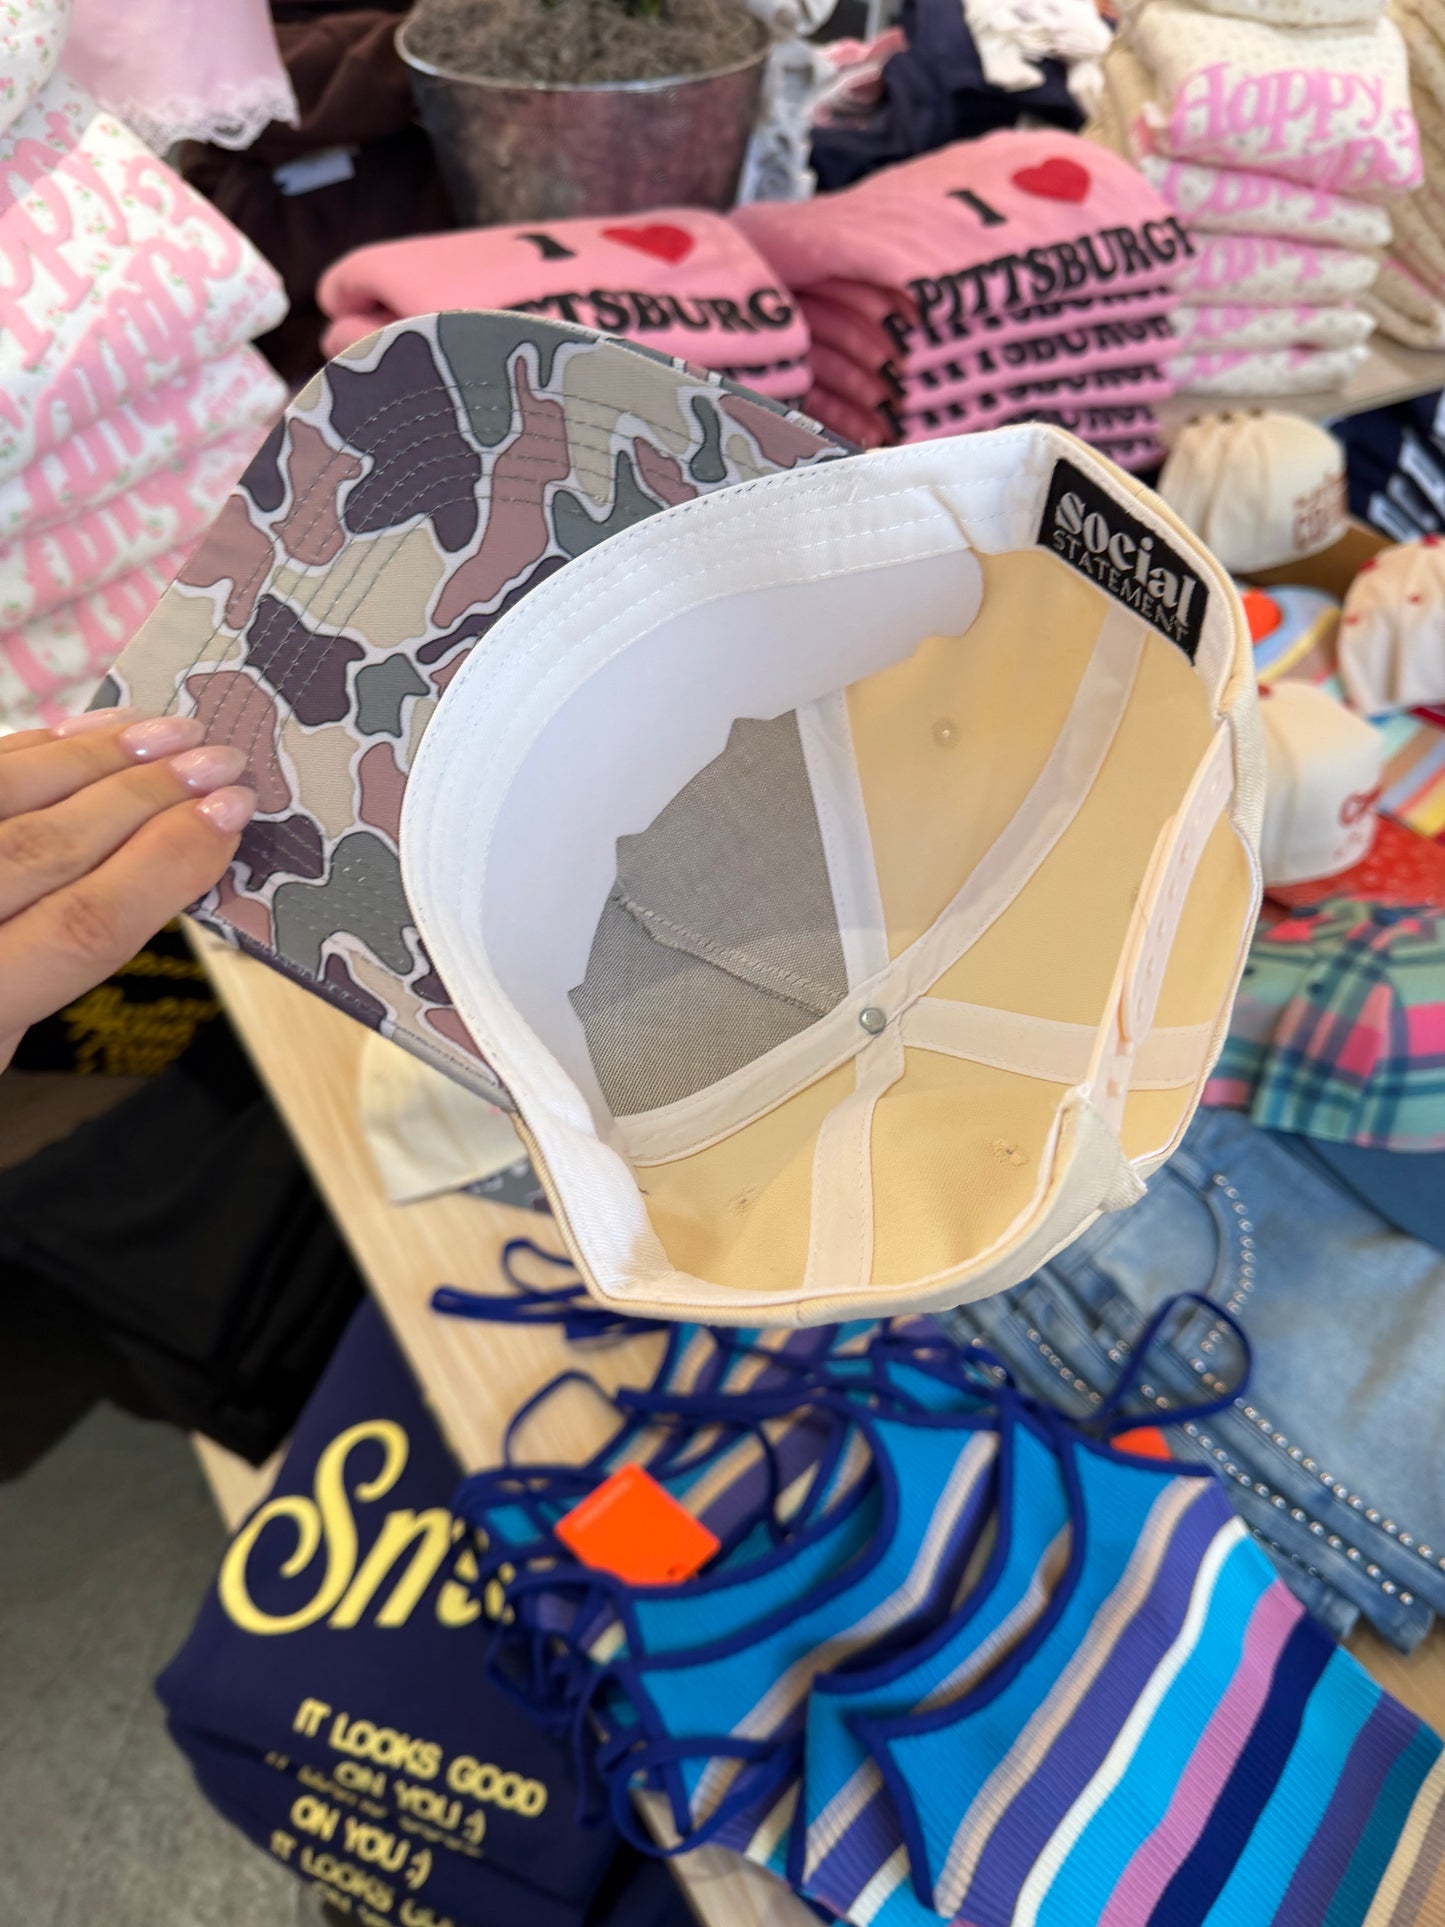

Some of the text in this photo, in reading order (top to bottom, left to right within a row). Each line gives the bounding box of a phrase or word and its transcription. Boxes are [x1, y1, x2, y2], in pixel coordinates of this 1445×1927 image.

[946, 188, 1007, 226] I
[514, 232, 577, 261] I
[1053, 530, 1188, 641] STATEMENT
[293, 1697, 331, 1738] IT
[328, 1711, 443, 1780] LOOKS
[446, 1754, 547, 1818] GOOD
[290, 1795, 340, 1842] ON
[344, 1815, 411, 1872] YOU
